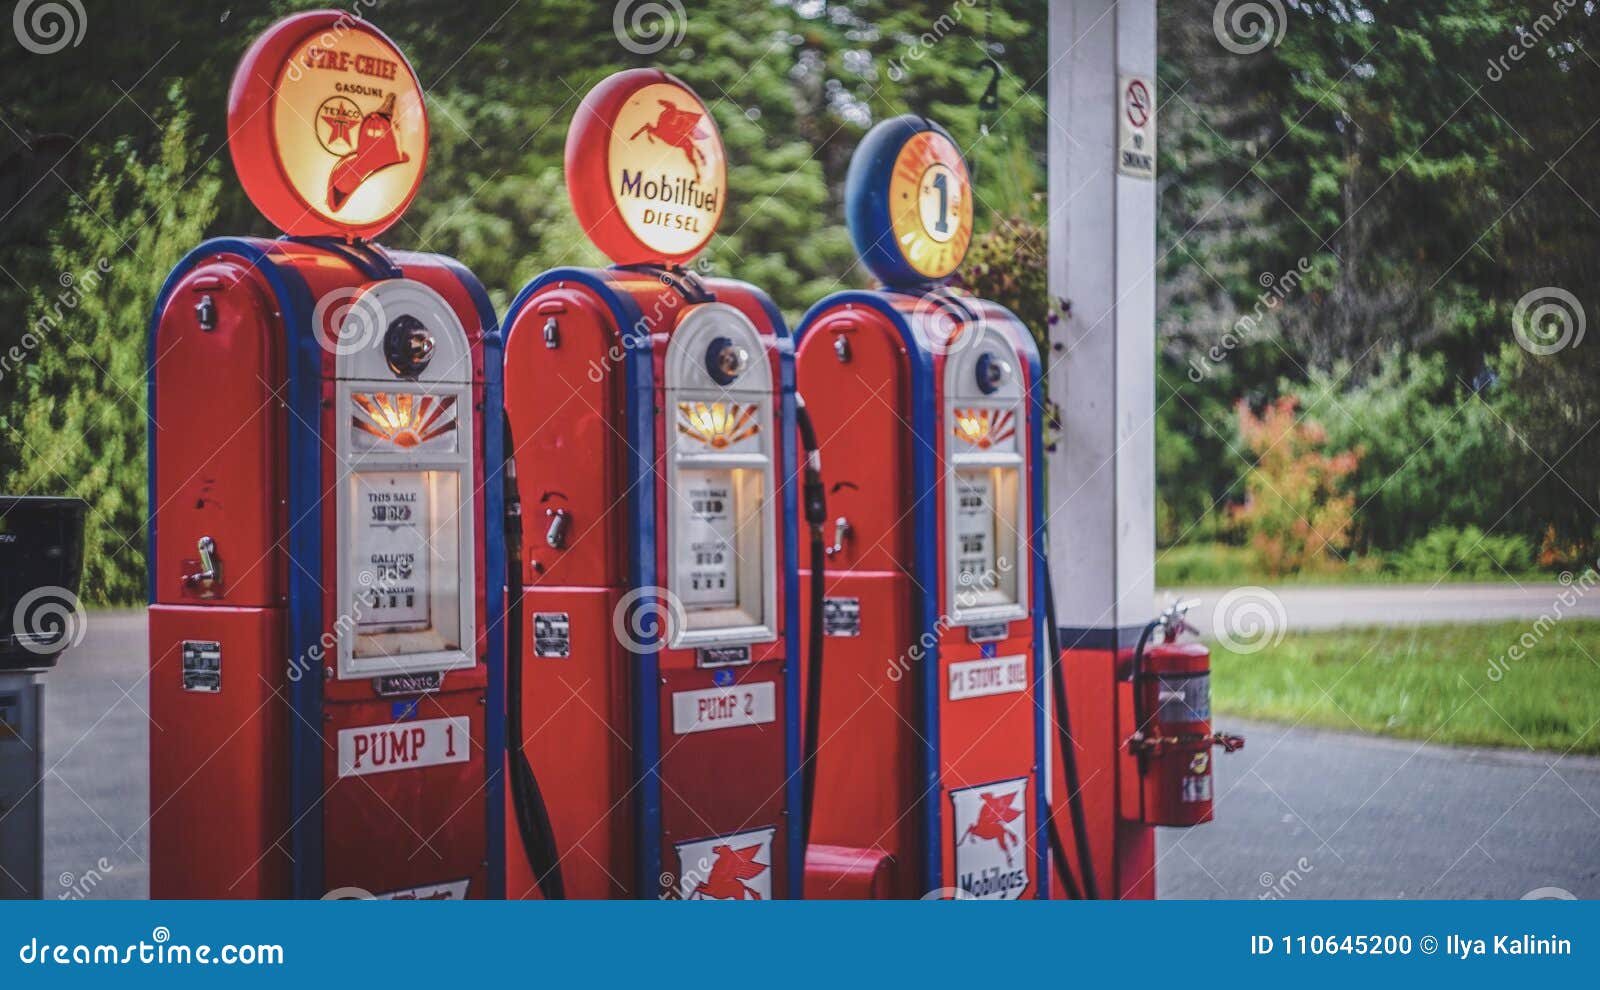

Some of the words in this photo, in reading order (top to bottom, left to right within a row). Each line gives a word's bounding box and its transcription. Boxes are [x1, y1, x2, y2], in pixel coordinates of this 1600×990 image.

[335, 82, 384, 98] GASOLINE
[620, 168, 718, 212] Mobilfuel
[933, 172, 948, 233] 1
[643, 209, 699, 232] DIESEL
[368, 493, 391, 502] THIS
[393, 493, 416, 502] SALE
[698, 695, 737, 722] PUMP
[744, 693, 754, 716] 2
[353, 728, 425, 768] PUMP
[445, 724, 456, 757] 1
